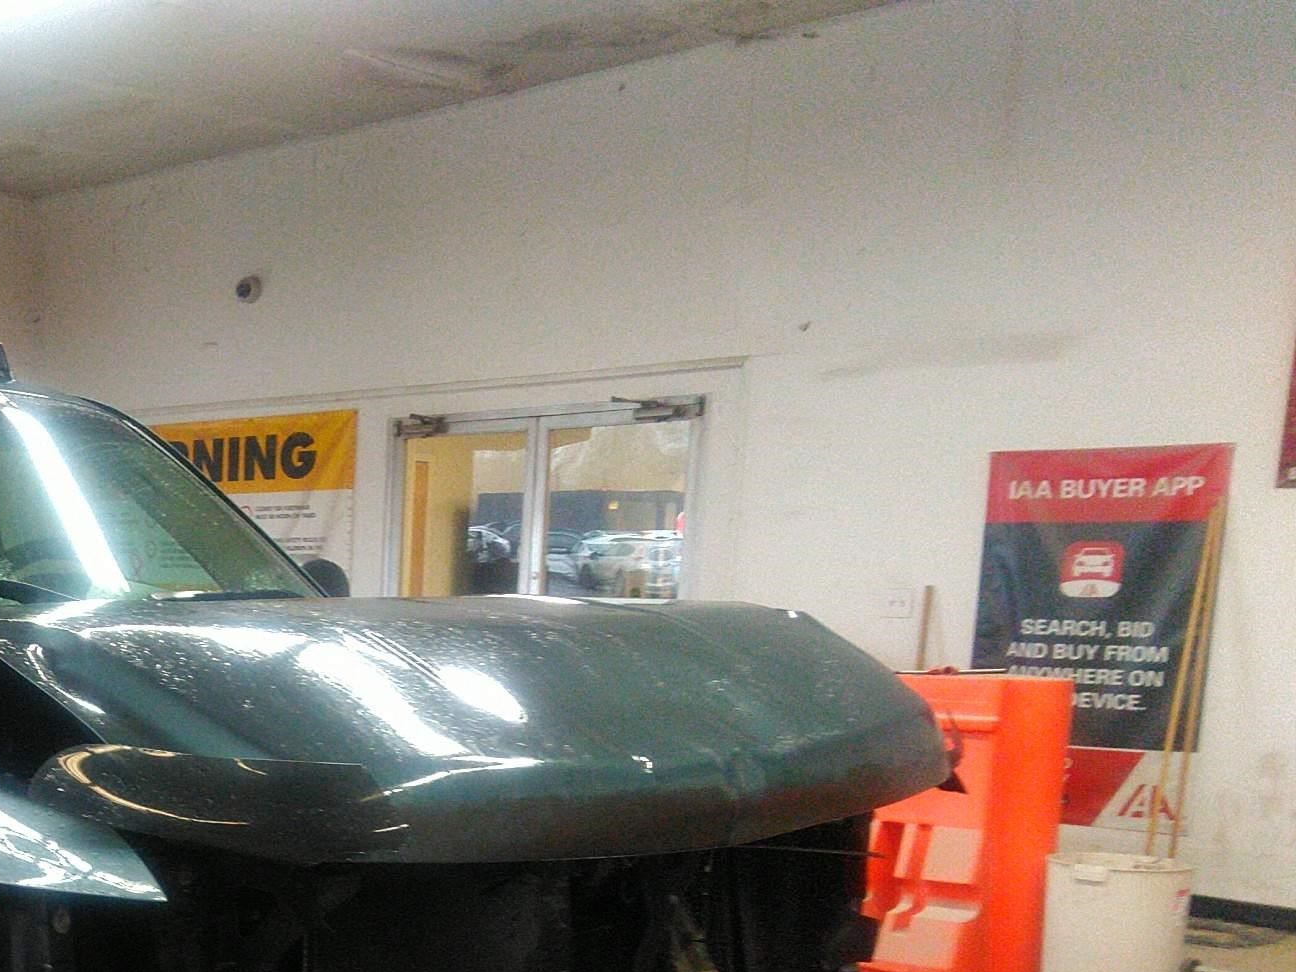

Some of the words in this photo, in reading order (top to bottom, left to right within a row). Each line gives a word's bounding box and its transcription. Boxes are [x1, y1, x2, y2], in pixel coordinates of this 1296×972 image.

[1008, 479, 1053, 500] IAA
[1060, 477, 1147, 499] BUYER
[1152, 475, 1206, 497] APP
[1020, 618, 1113, 639] SEARCH,
[1117, 620, 1155, 639] BID
[1005, 641, 1048, 659] AND
[1052, 642, 1099, 661] BUY
[1104, 644, 1170, 663] FROM
[1128, 669, 1165, 688] ON
